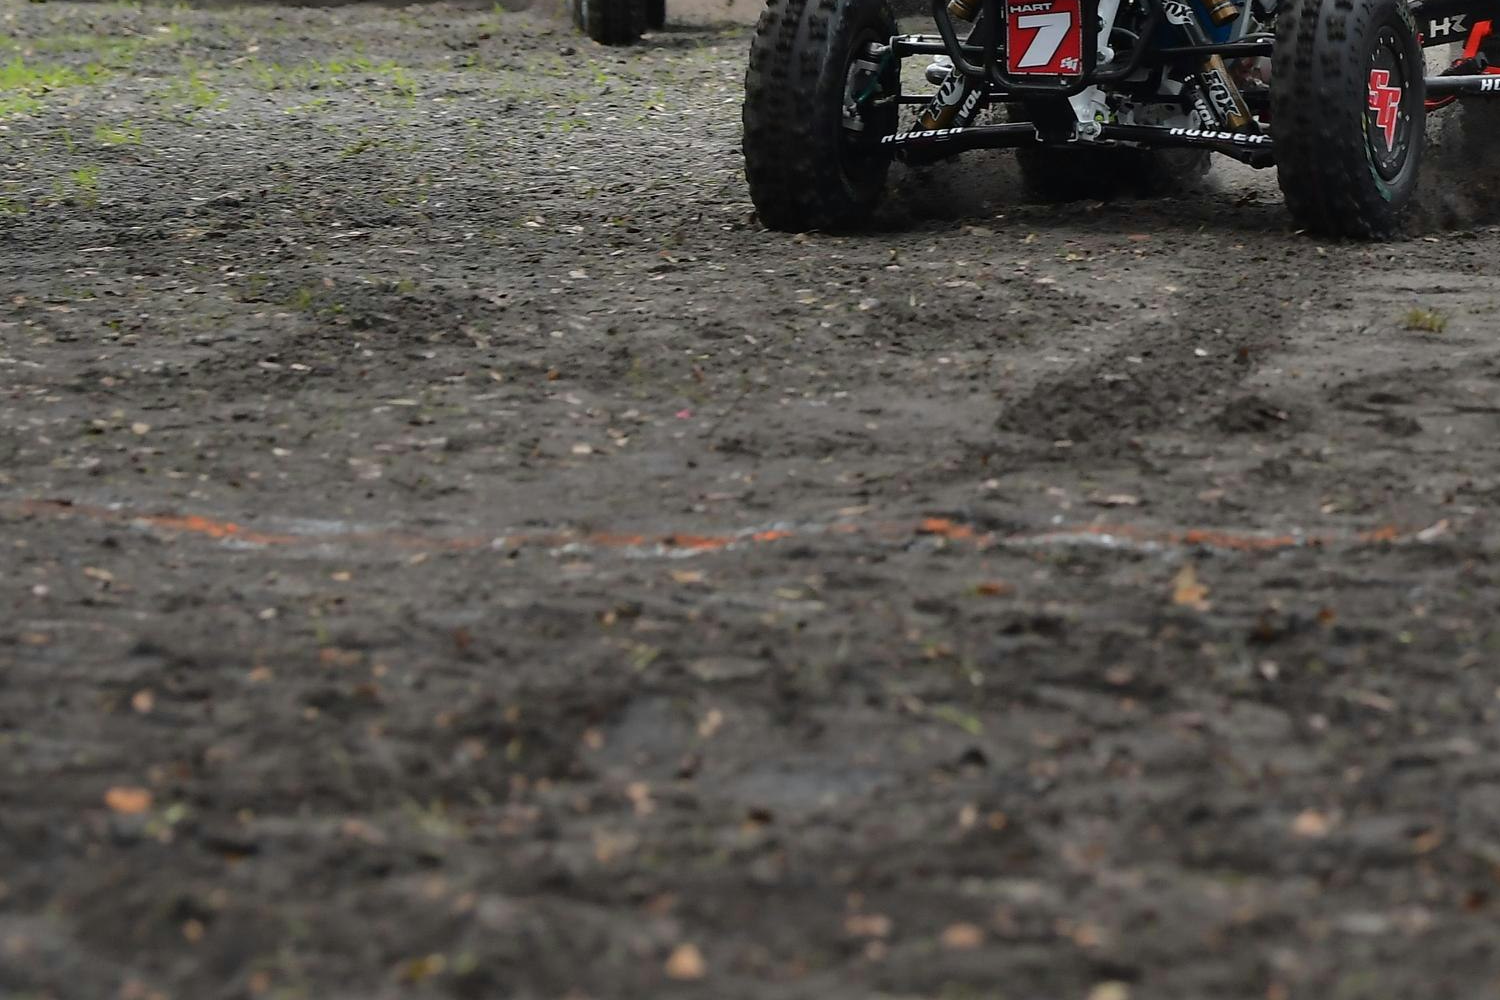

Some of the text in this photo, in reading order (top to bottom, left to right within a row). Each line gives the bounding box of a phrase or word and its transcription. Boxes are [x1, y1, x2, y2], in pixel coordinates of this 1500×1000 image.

[1009, 2, 1053, 14] HART
[1017, 11, 1072, 69] 7
[1201, 68, 1243, 118] FOX
